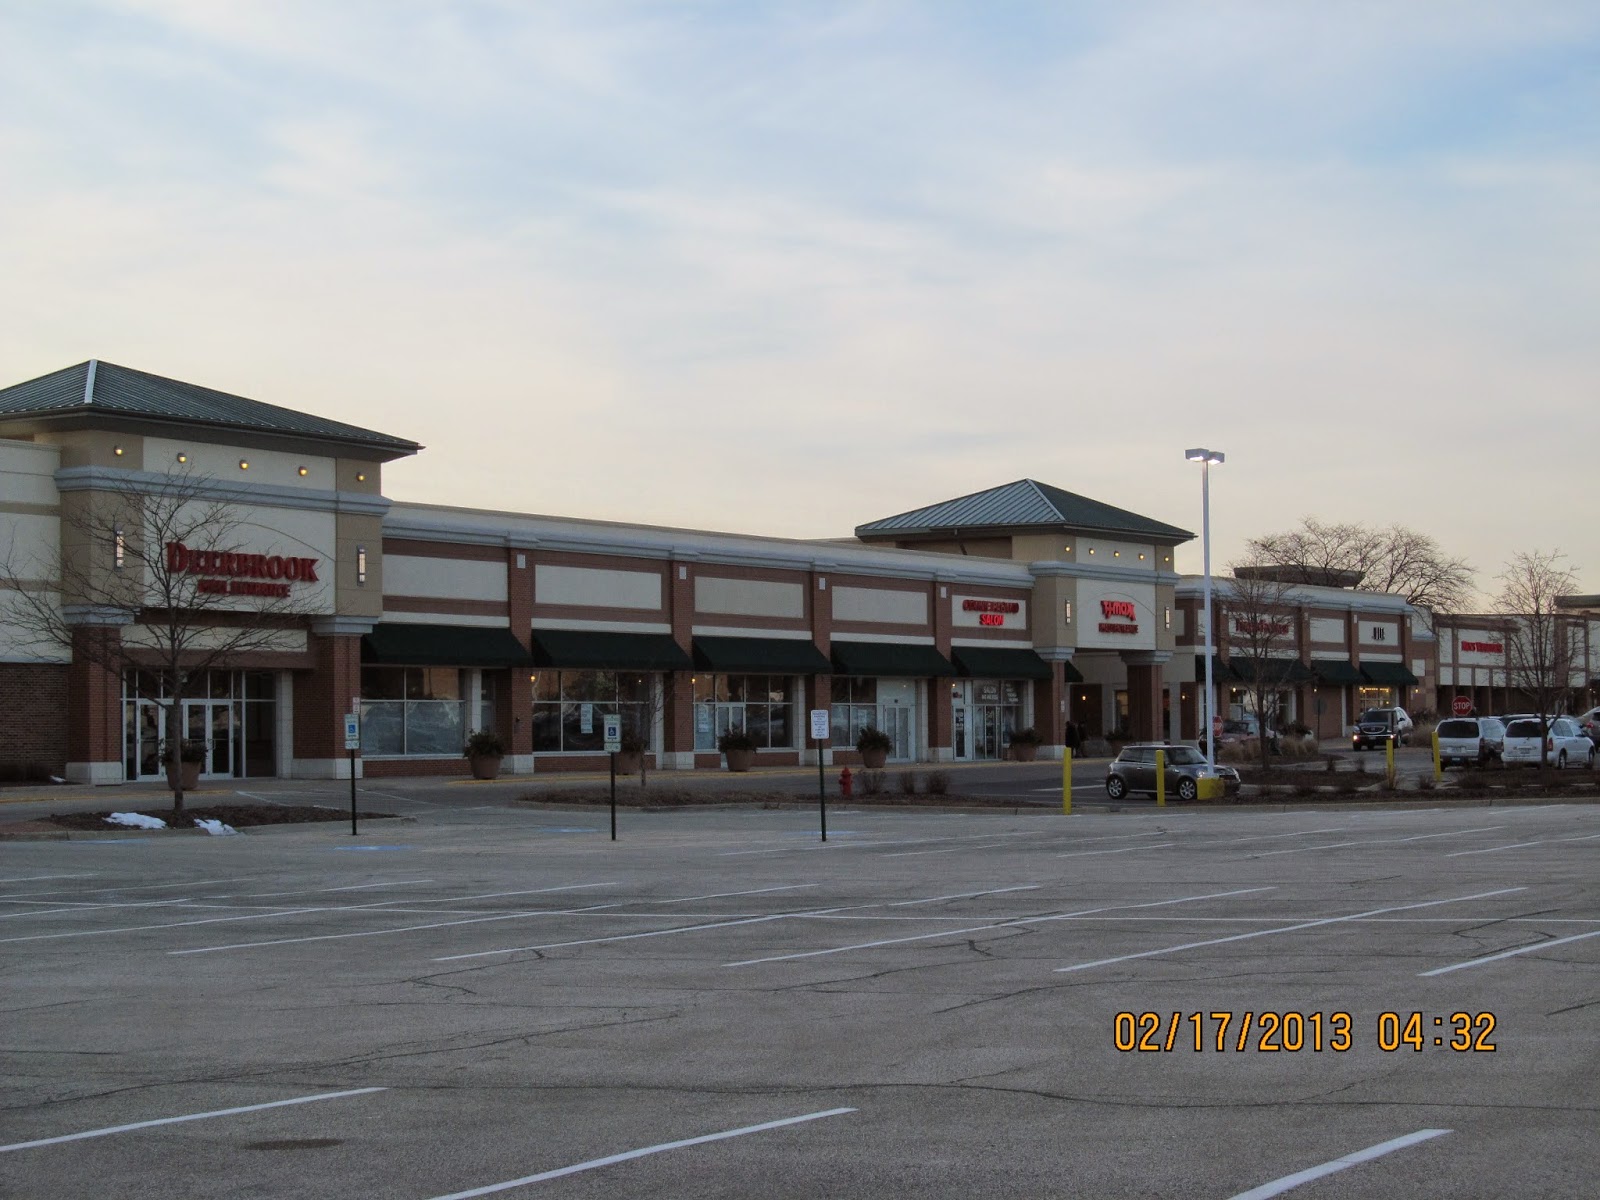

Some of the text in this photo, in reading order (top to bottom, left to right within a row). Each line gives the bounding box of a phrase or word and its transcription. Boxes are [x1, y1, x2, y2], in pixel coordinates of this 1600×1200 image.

[165, 542, 319, 582] DEERBROOK
[979, 614, 1005, 626] SALON
[1453, 702, 1471, 710] STOP
